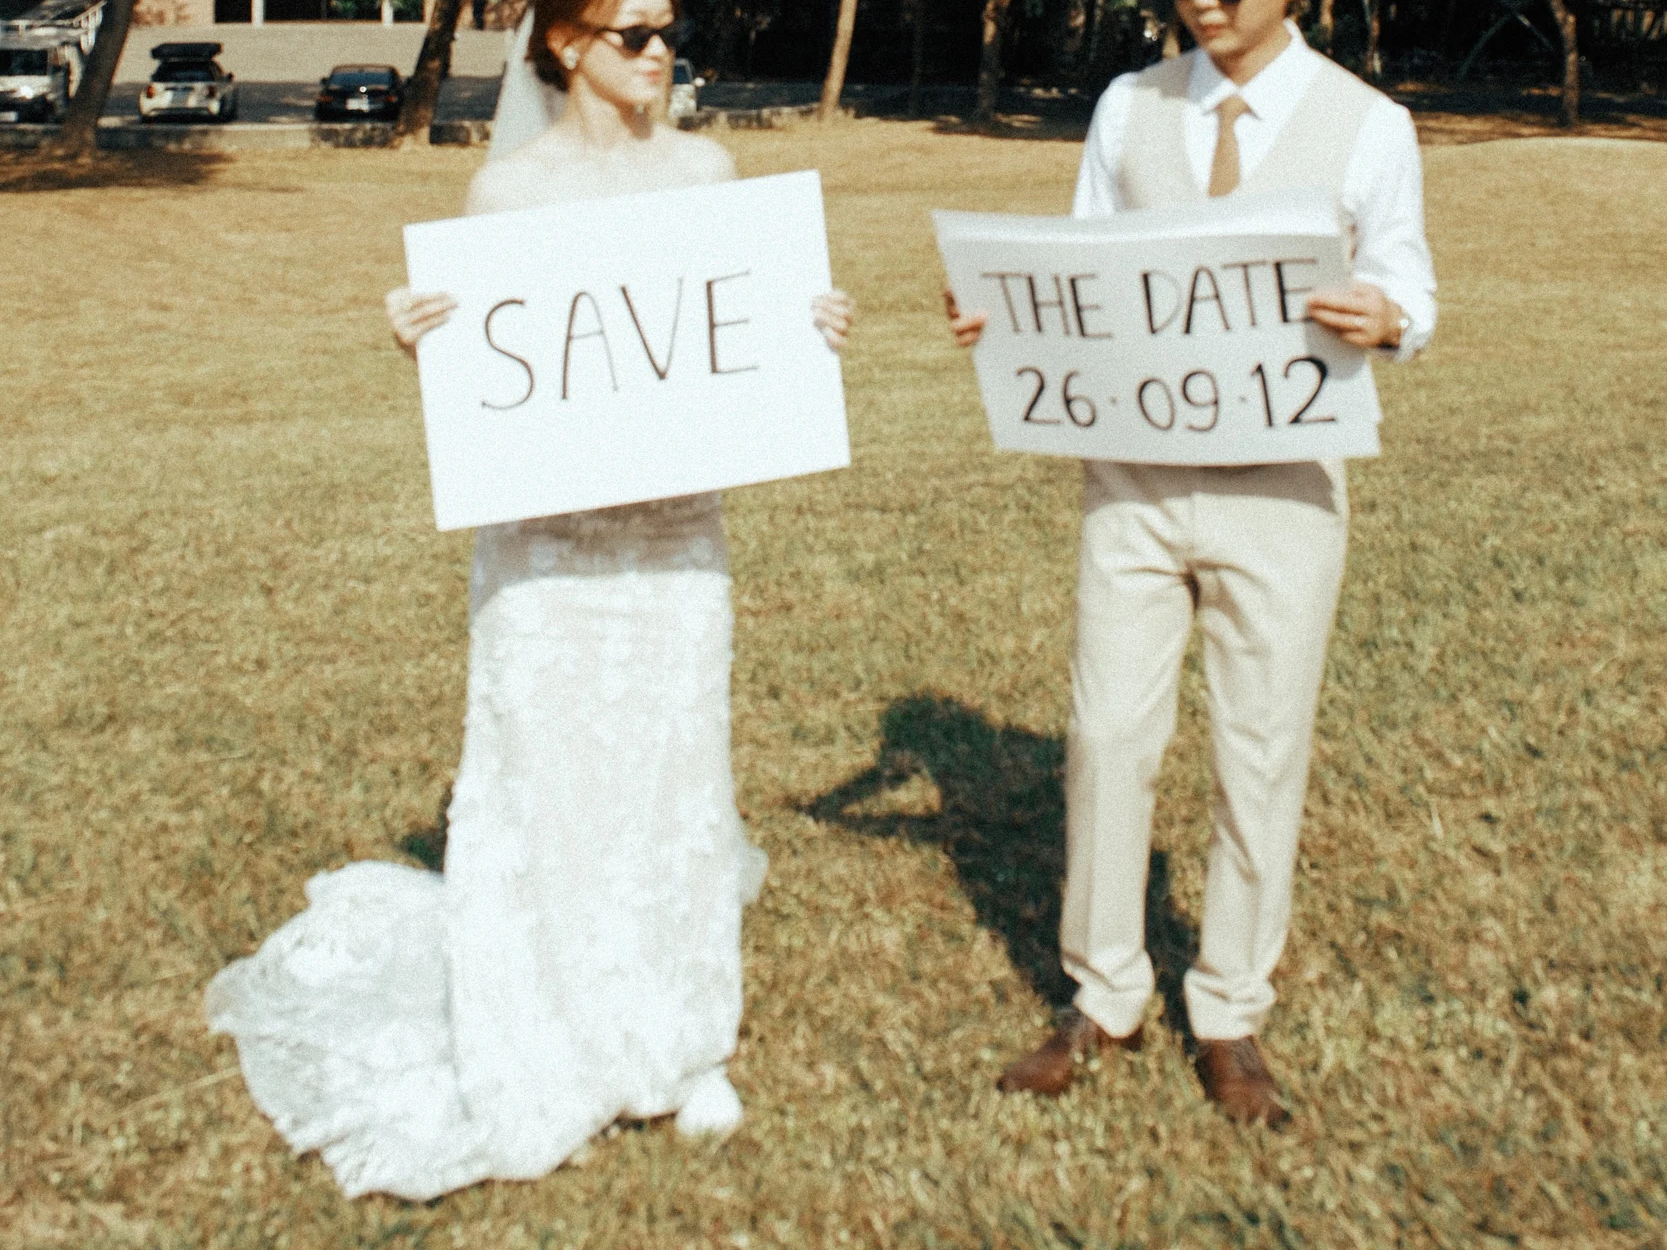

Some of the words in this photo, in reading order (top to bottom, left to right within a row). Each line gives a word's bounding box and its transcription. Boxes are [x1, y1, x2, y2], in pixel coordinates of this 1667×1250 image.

[481, 269, 759, 410] SAVE
[981, 272, 1113, 339] THE
[1140, 258, 1319, 336] DATE
